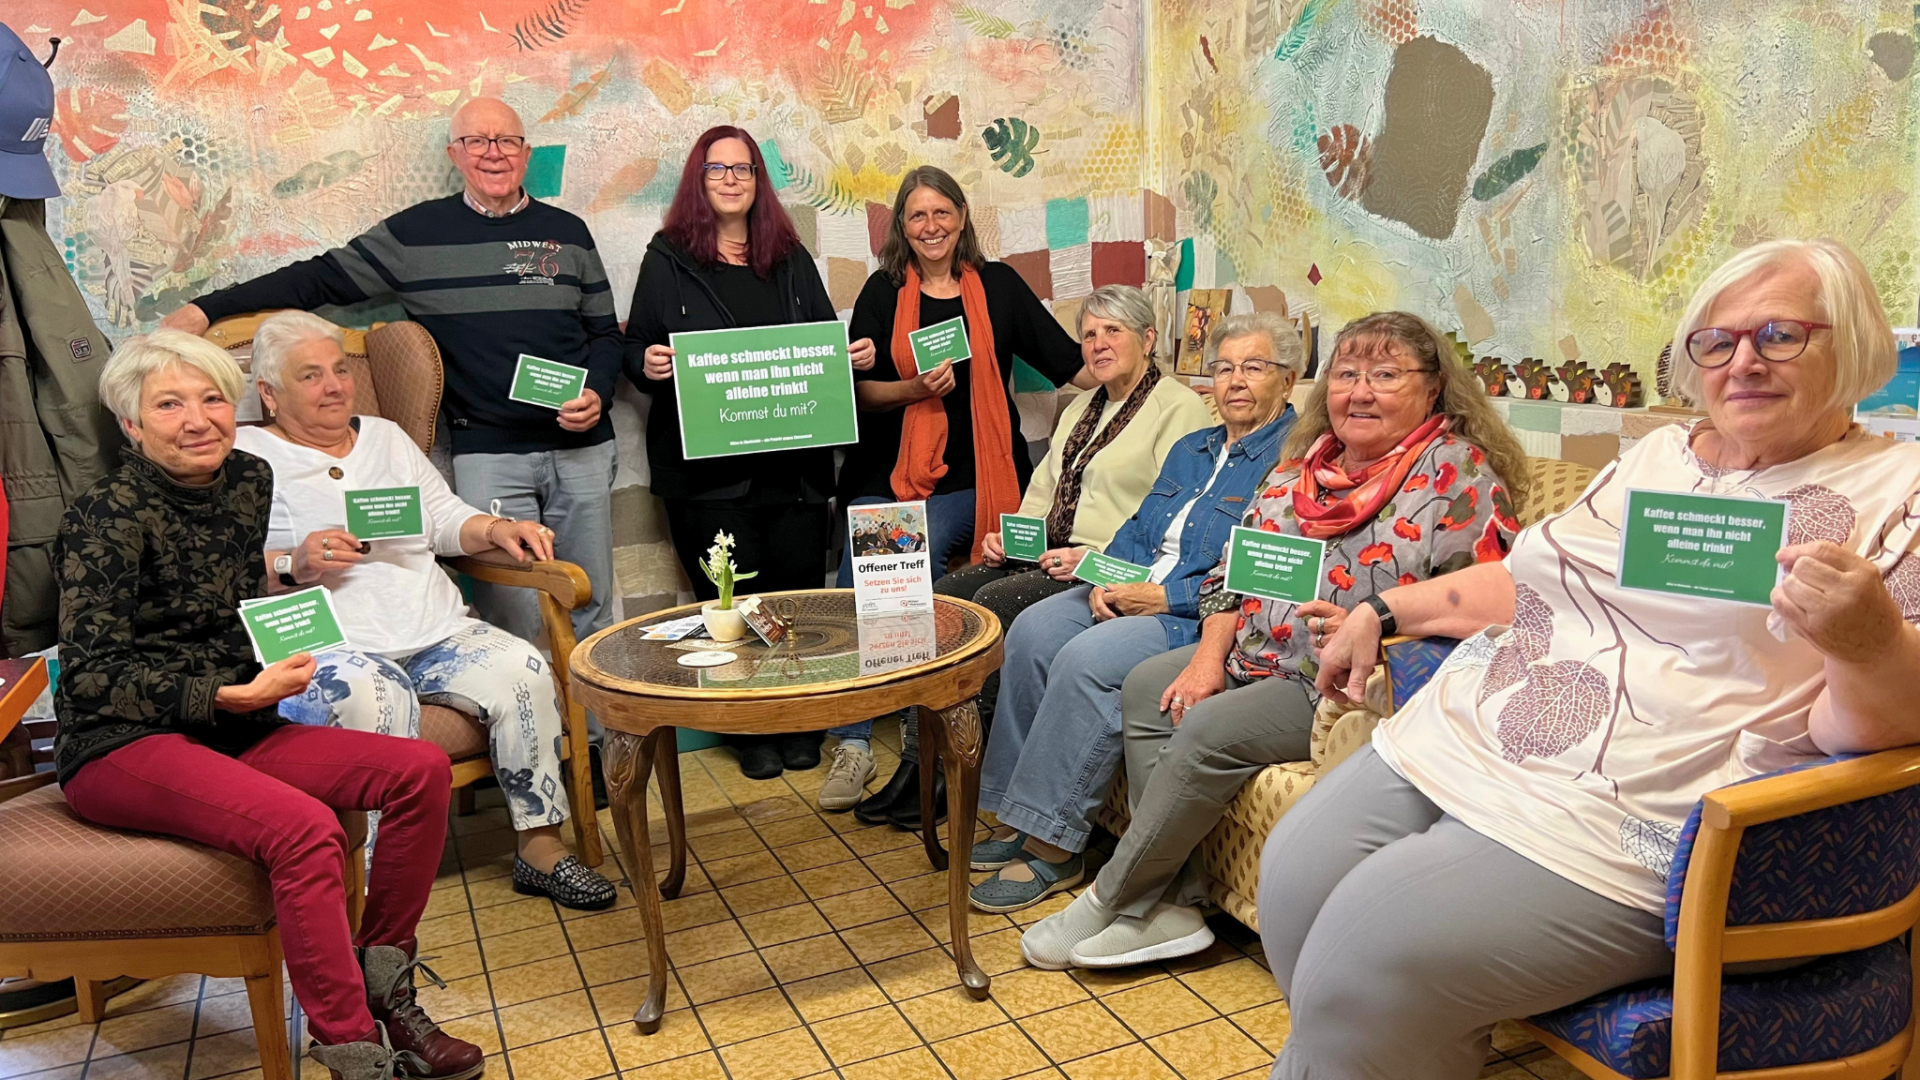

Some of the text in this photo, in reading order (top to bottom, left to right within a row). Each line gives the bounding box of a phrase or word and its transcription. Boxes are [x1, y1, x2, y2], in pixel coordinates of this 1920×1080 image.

[507, 241, 562, 252] MIDWEST
[515, 251, 559, 277] 76
[688, 344, 836, 367] Kaffee schmeckt besser,
[705, 362, 824, 384] wenn man ihn nicht
[726, 381, 808, 400] alleine trinkt!
[720, 400, 817, 423] Kommst du mit?
[1644, 508, 1765, 529] Kaffee schmeckt besser,
[1654, 524, 1751, 542] wenn man ihn nicht
[1667, 539, 1733, 554] alleine trinkt!
[858, 559, 924, 573] Offener Treff
[864, 578, 890, 587] Setzen
